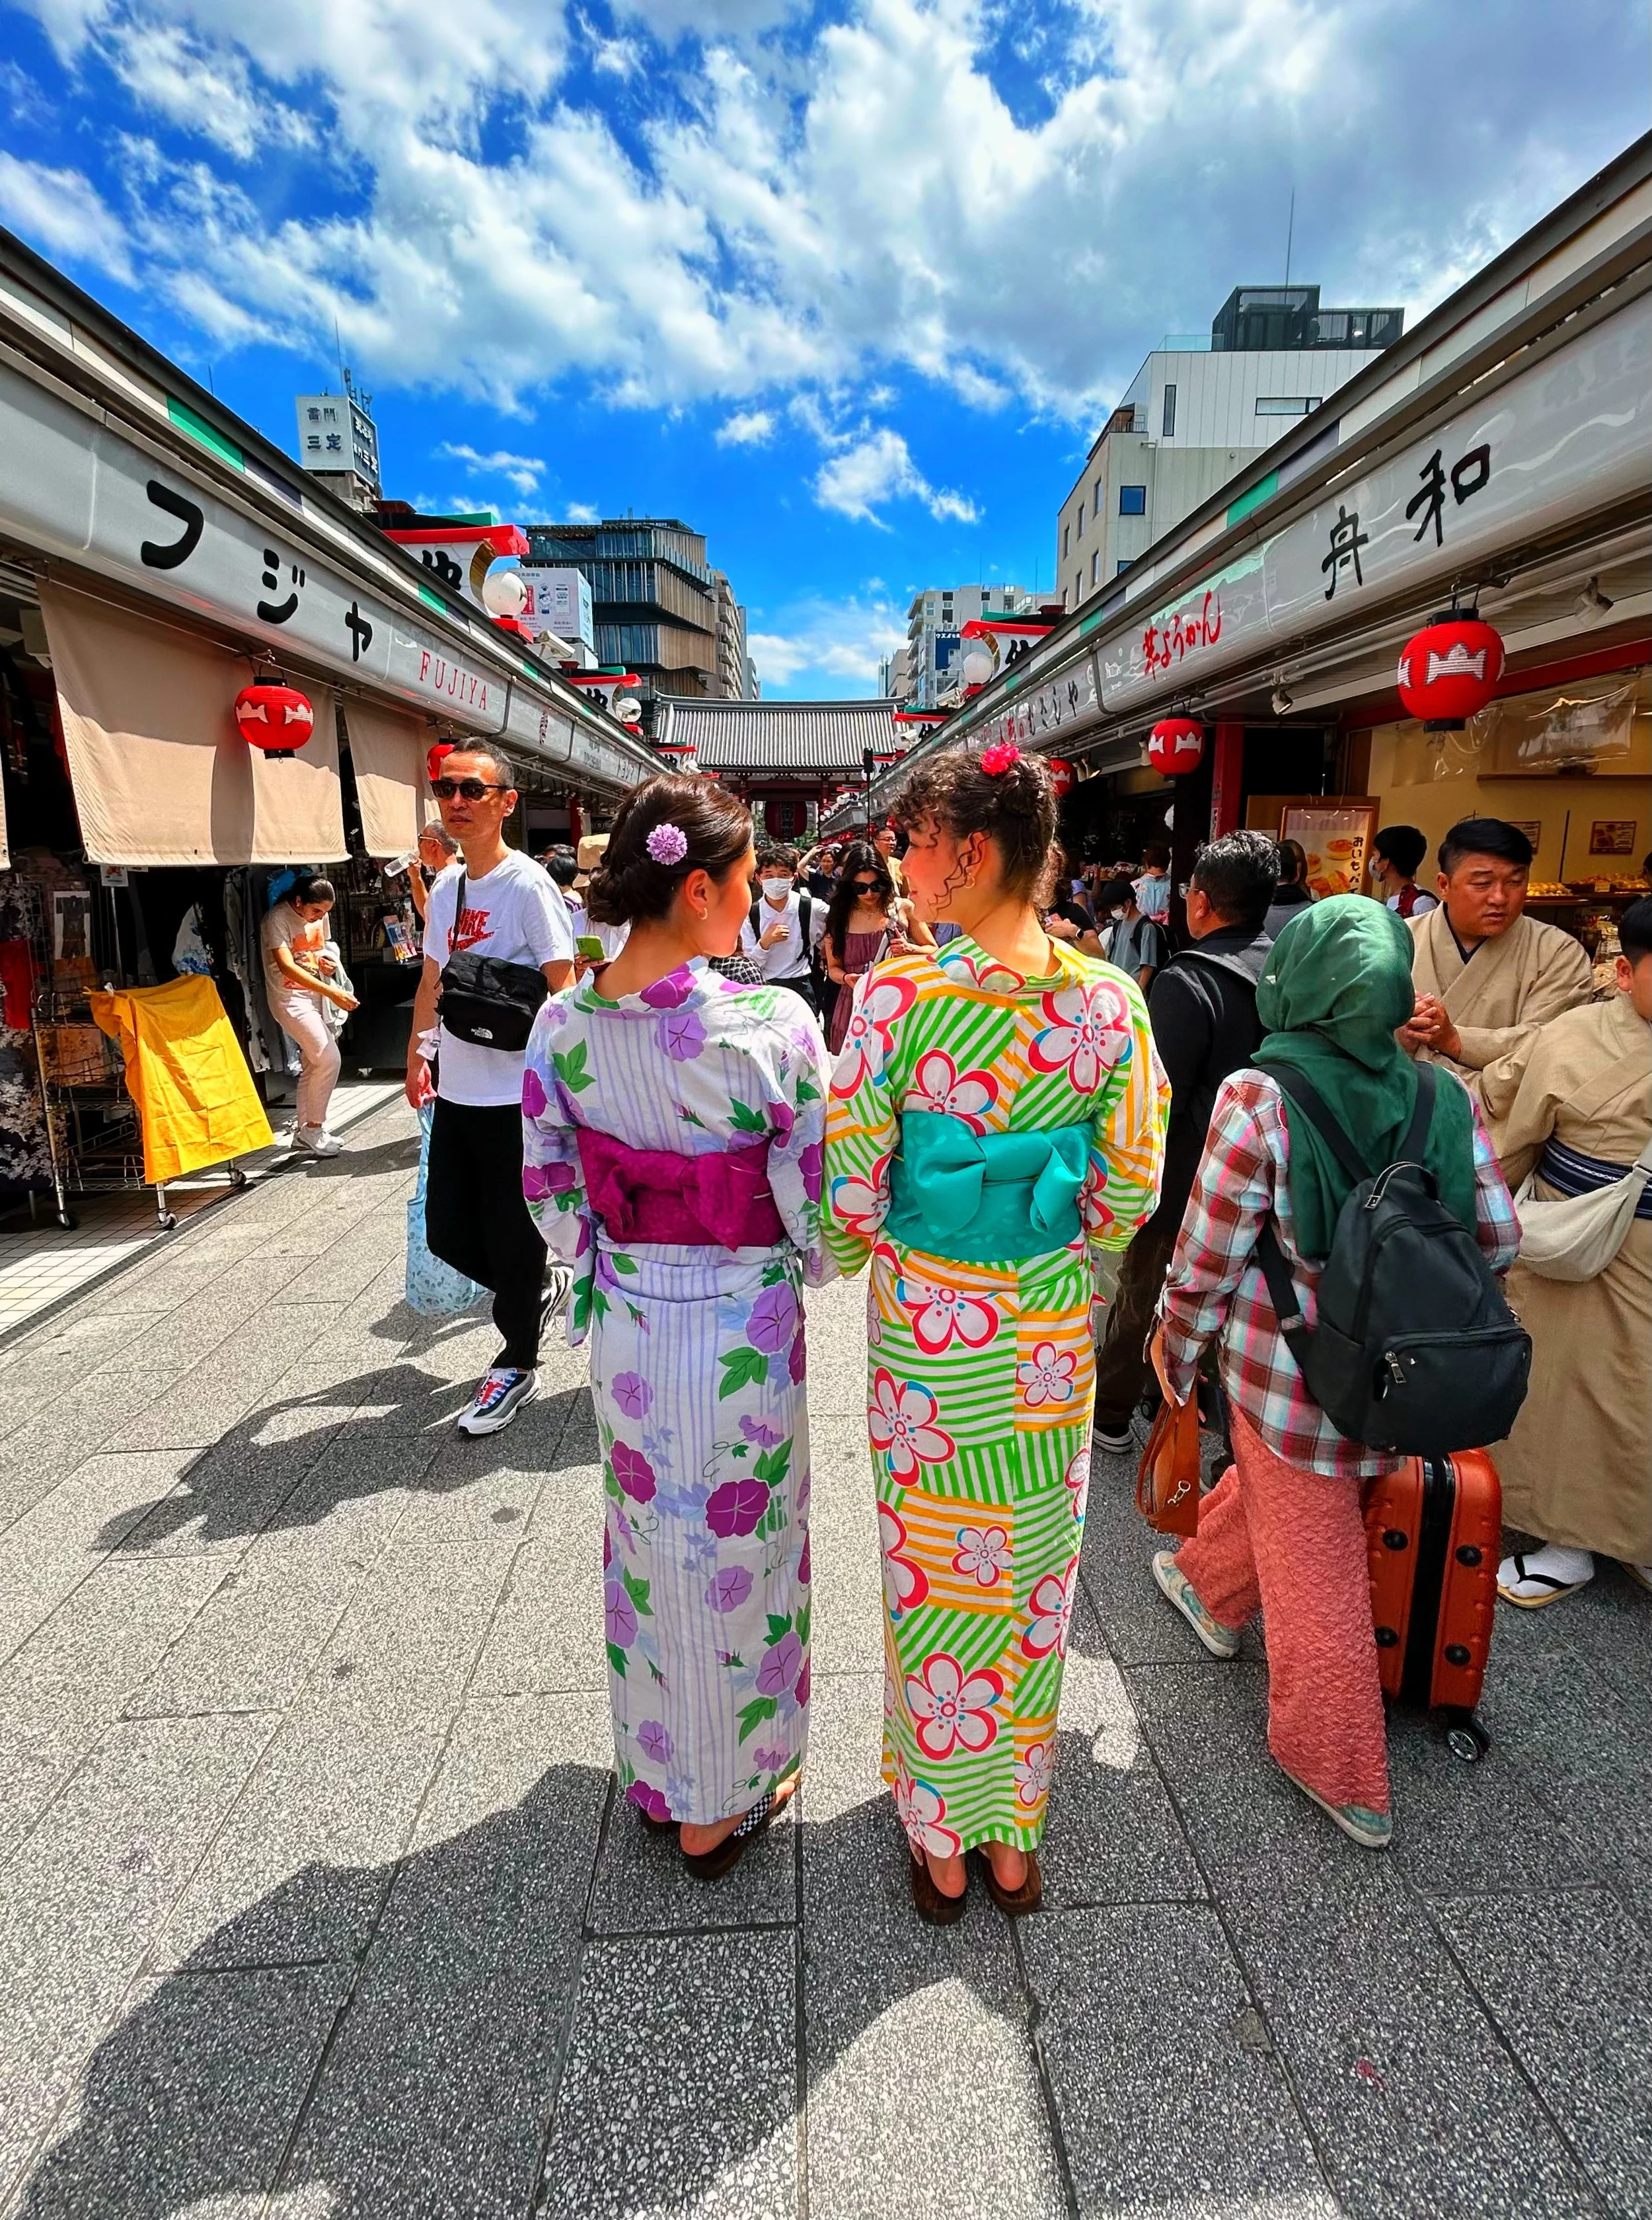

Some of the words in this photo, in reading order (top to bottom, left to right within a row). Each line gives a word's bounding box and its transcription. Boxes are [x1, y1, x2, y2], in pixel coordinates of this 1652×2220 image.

[307, 406, 336, 422] 雷門
[307, 433, 342, 451] 三定
[1322, 443, 1491, 601] 舟和
[141, 479, 373, 662] フジヤ
[419, 650, 486, 710] FUJIYA
